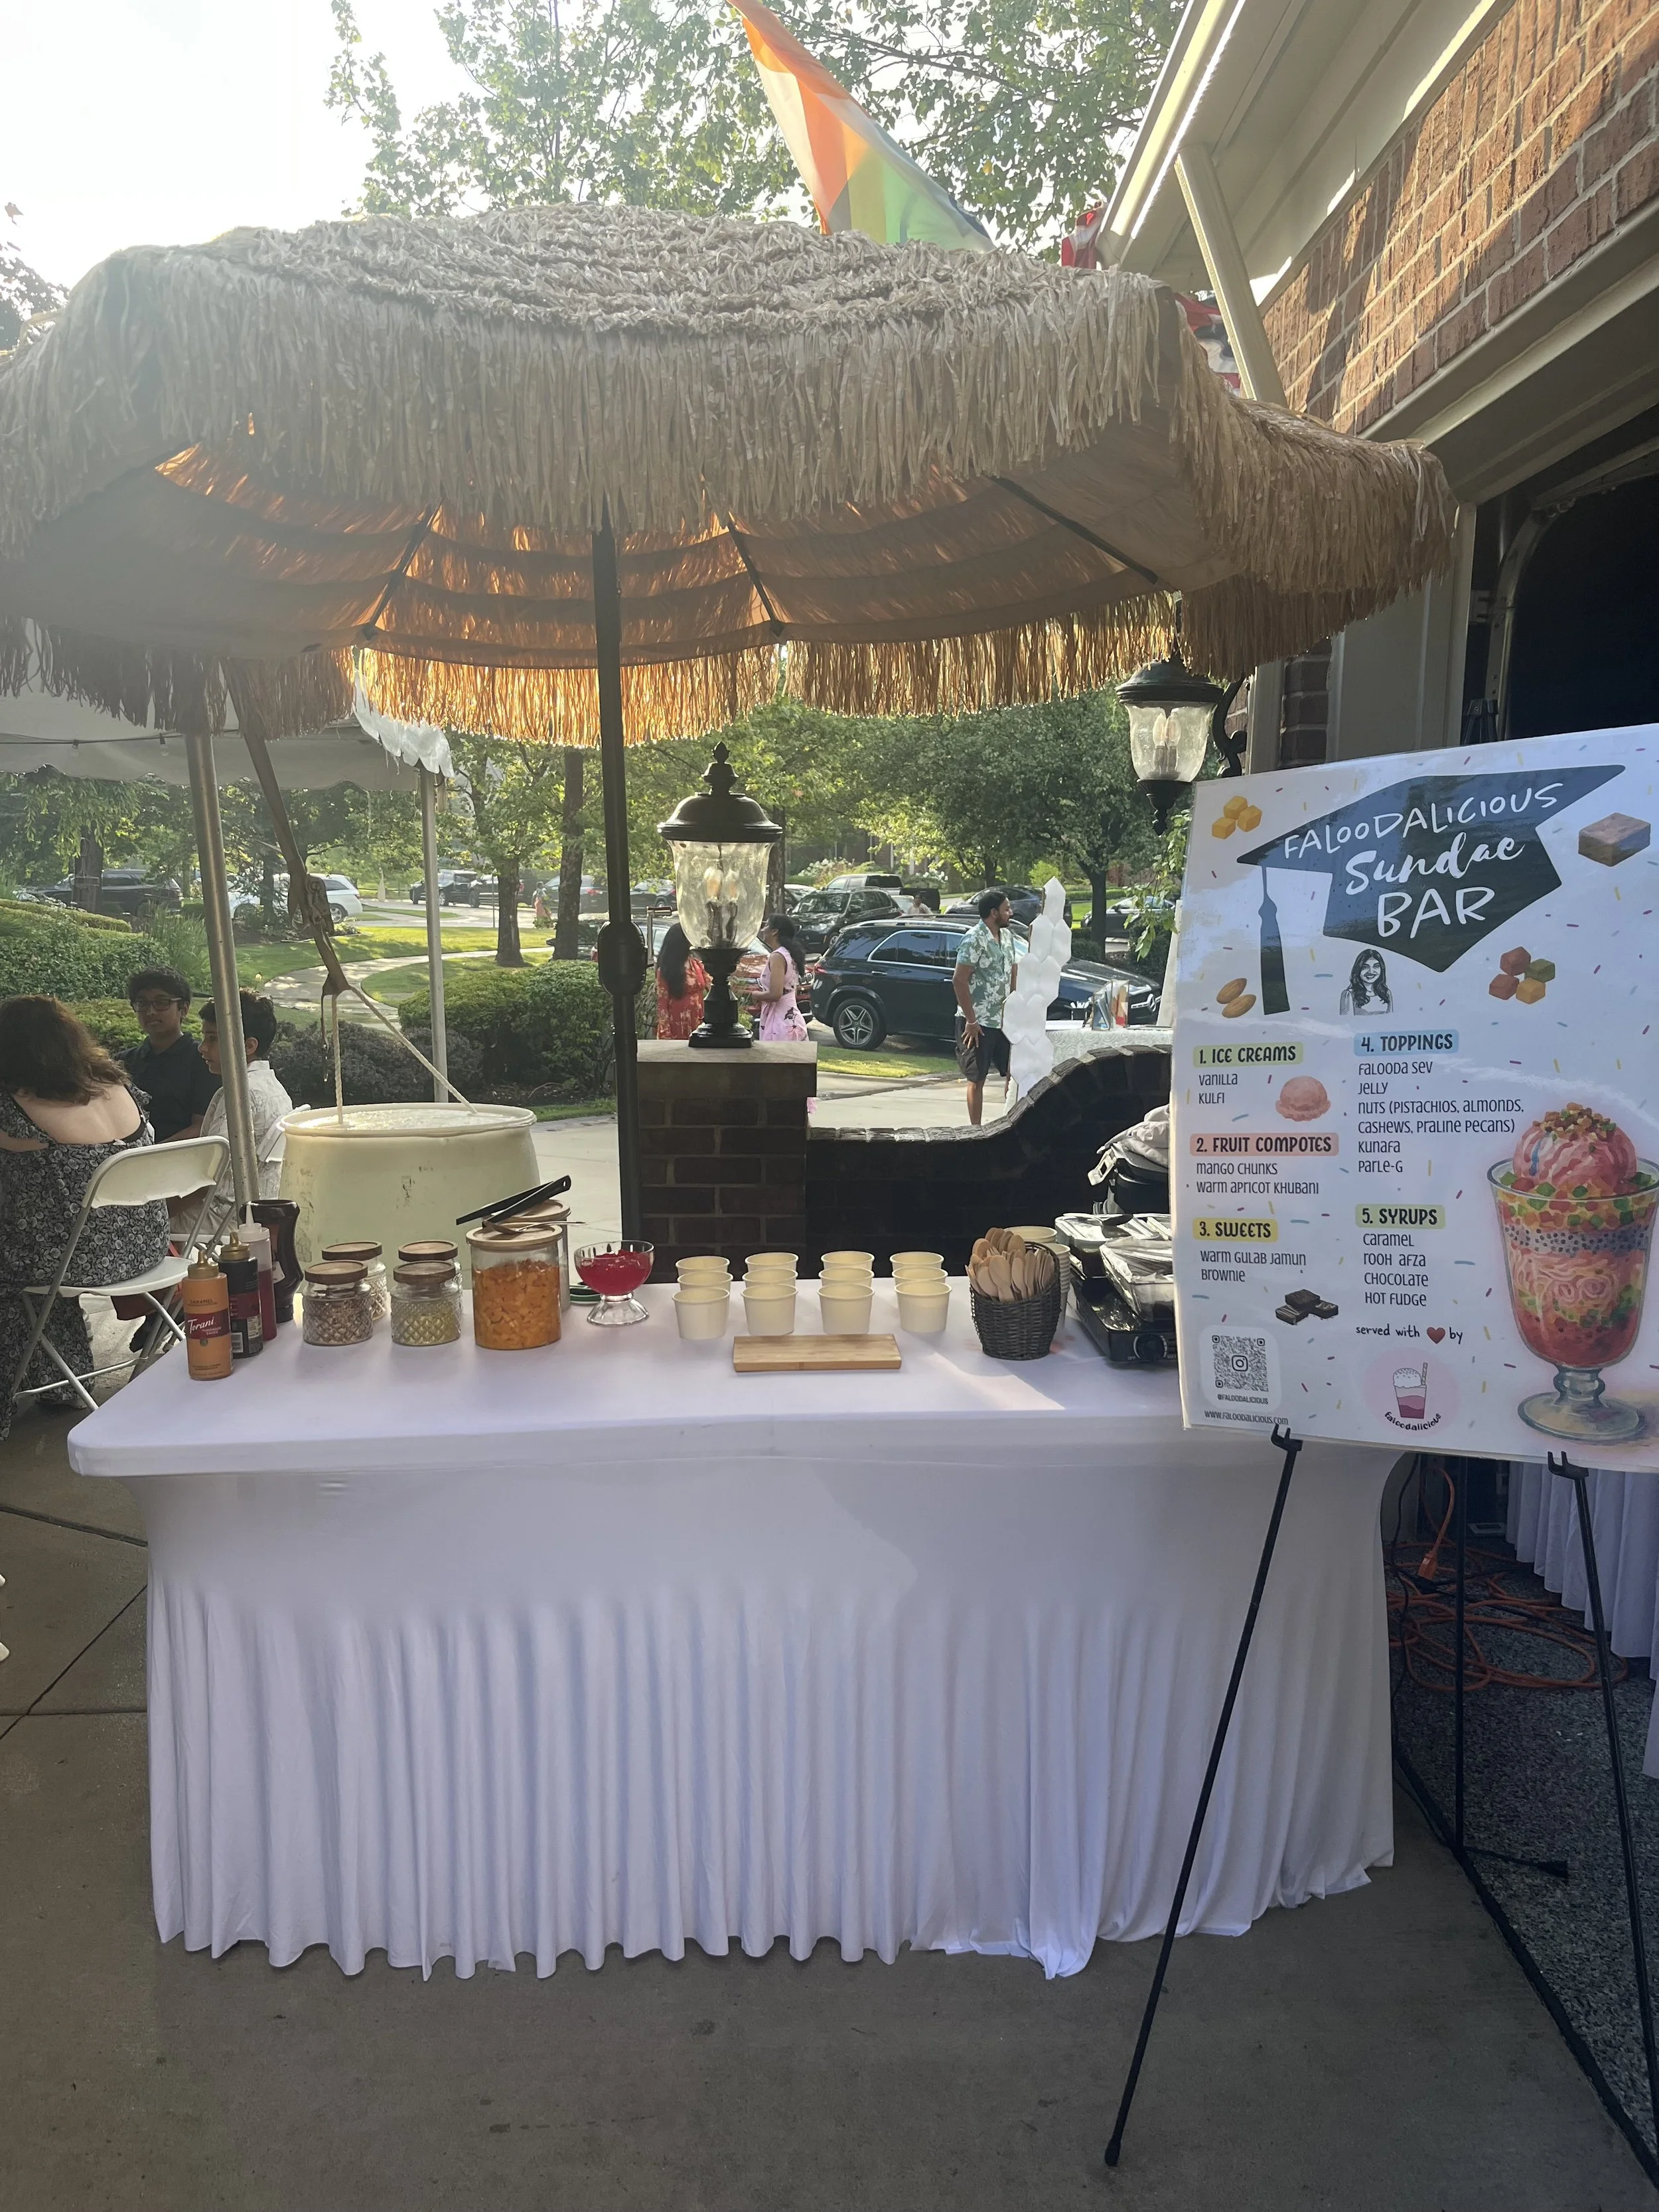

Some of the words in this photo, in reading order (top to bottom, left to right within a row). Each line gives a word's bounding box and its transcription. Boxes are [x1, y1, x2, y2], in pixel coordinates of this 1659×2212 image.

[1285, 783, 1563, 858] FALOODALICIOUS
[1345, 832, 1526, 895] Sundae
[1378, 887, 1495, 938] BAR
[1361, 1037, 1374, 1052] 4.
[1380, 1033, 1453, 1051] TOPPINGS
[1198, 1049, 1206, 1064] 1.
[1212, 1048, 1232, 1063] ICE
[1238, 1045, 1296, 1063] CREAMS
[1196, 1138, 1208, 1152] 2.
[1213, 1138, 1250, 1152] FRUIT
[1256, 1136, 1331, 1152] COMPOTES
[1362, 1208, 1373, 1224] 5.
[1379, 1209, 1437, 1224] SYRUPS
[1199, 1221, 1210, 1236] 3.
[1215, 1222, 1271, 1238] SWEETS
[1365, 1291, 1386, 1305] HOT
[188, 1317, 214, 1334] Torani
[1356, 1323, 1390, 1336] served
[1396, 1325, 1420, 1337] with
[1449, 1327, 1463, 1345] by
[1217, 1394, 1268, 1404] @FALOODALICIOUS
[1384, 1411, 1441, 1431] faloodalicious
